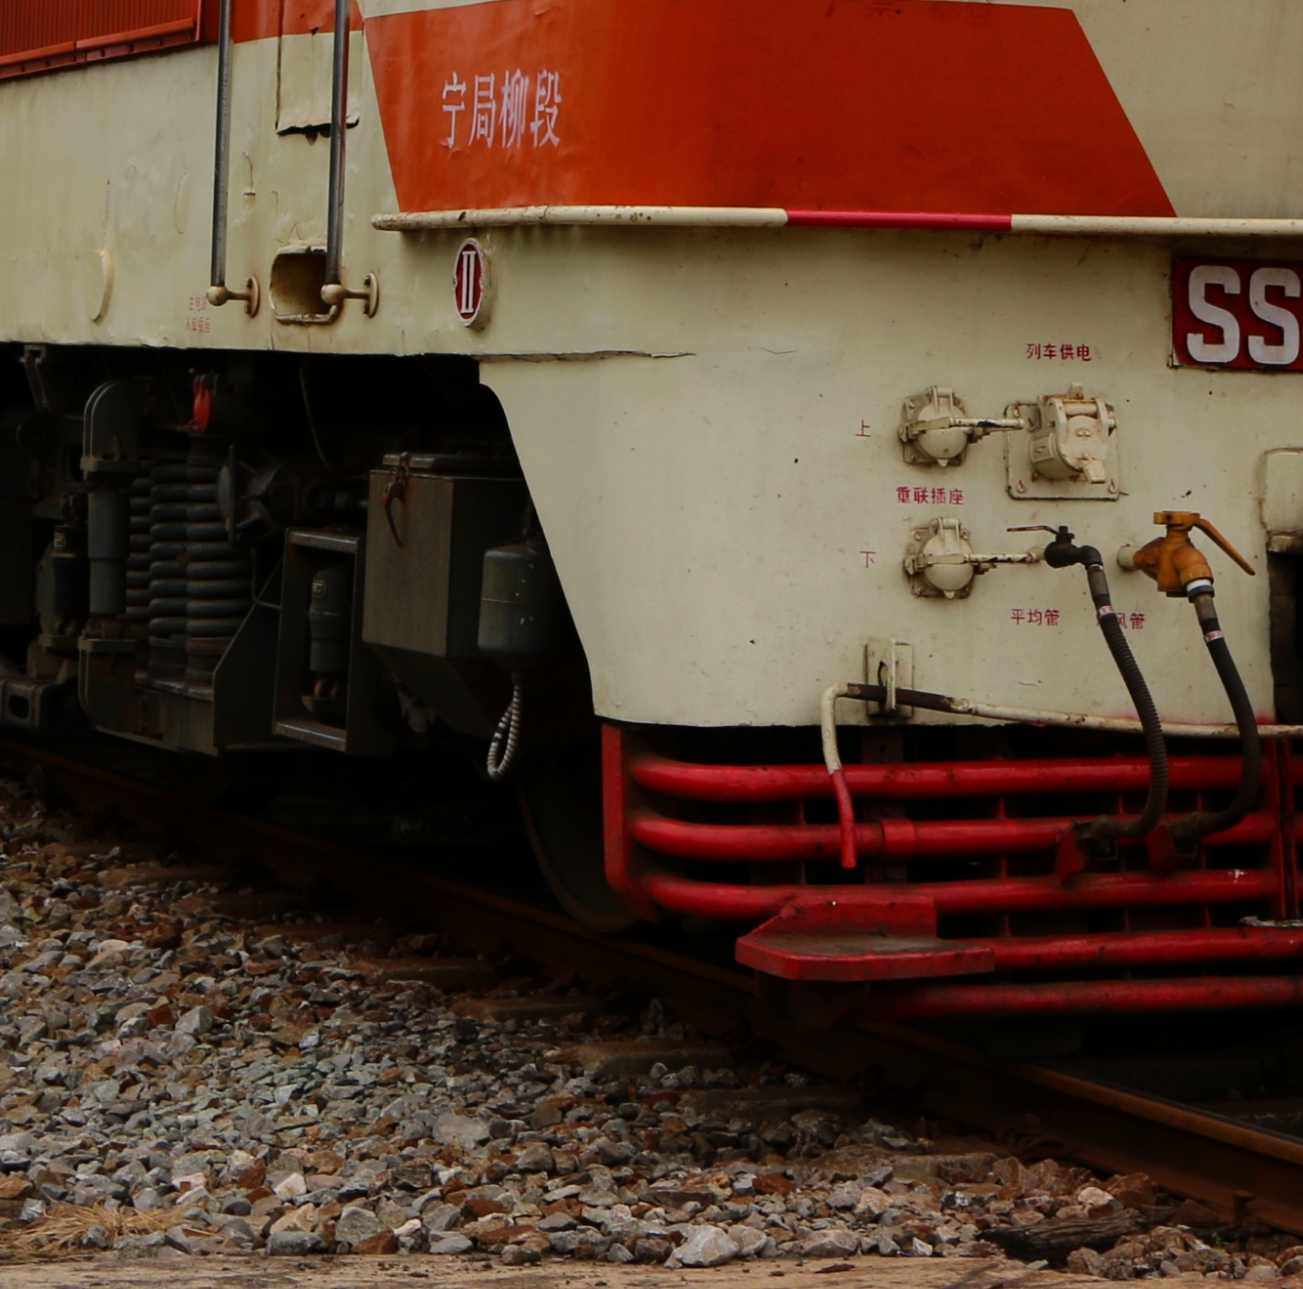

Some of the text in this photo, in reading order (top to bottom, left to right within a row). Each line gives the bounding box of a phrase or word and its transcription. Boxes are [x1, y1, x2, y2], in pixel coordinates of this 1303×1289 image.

[442, 68, 563, 150] 宁局柳段
[1026, 343, 1092, 362] 列车供电
[855, 420, 871, 438] 上
[895, 486, 965, 506] 重联插座
[859, 551, 876, 569] 下
[1010, 608, 1060, 626] 平均管
[1096, 612, 1146, 630] 风管
